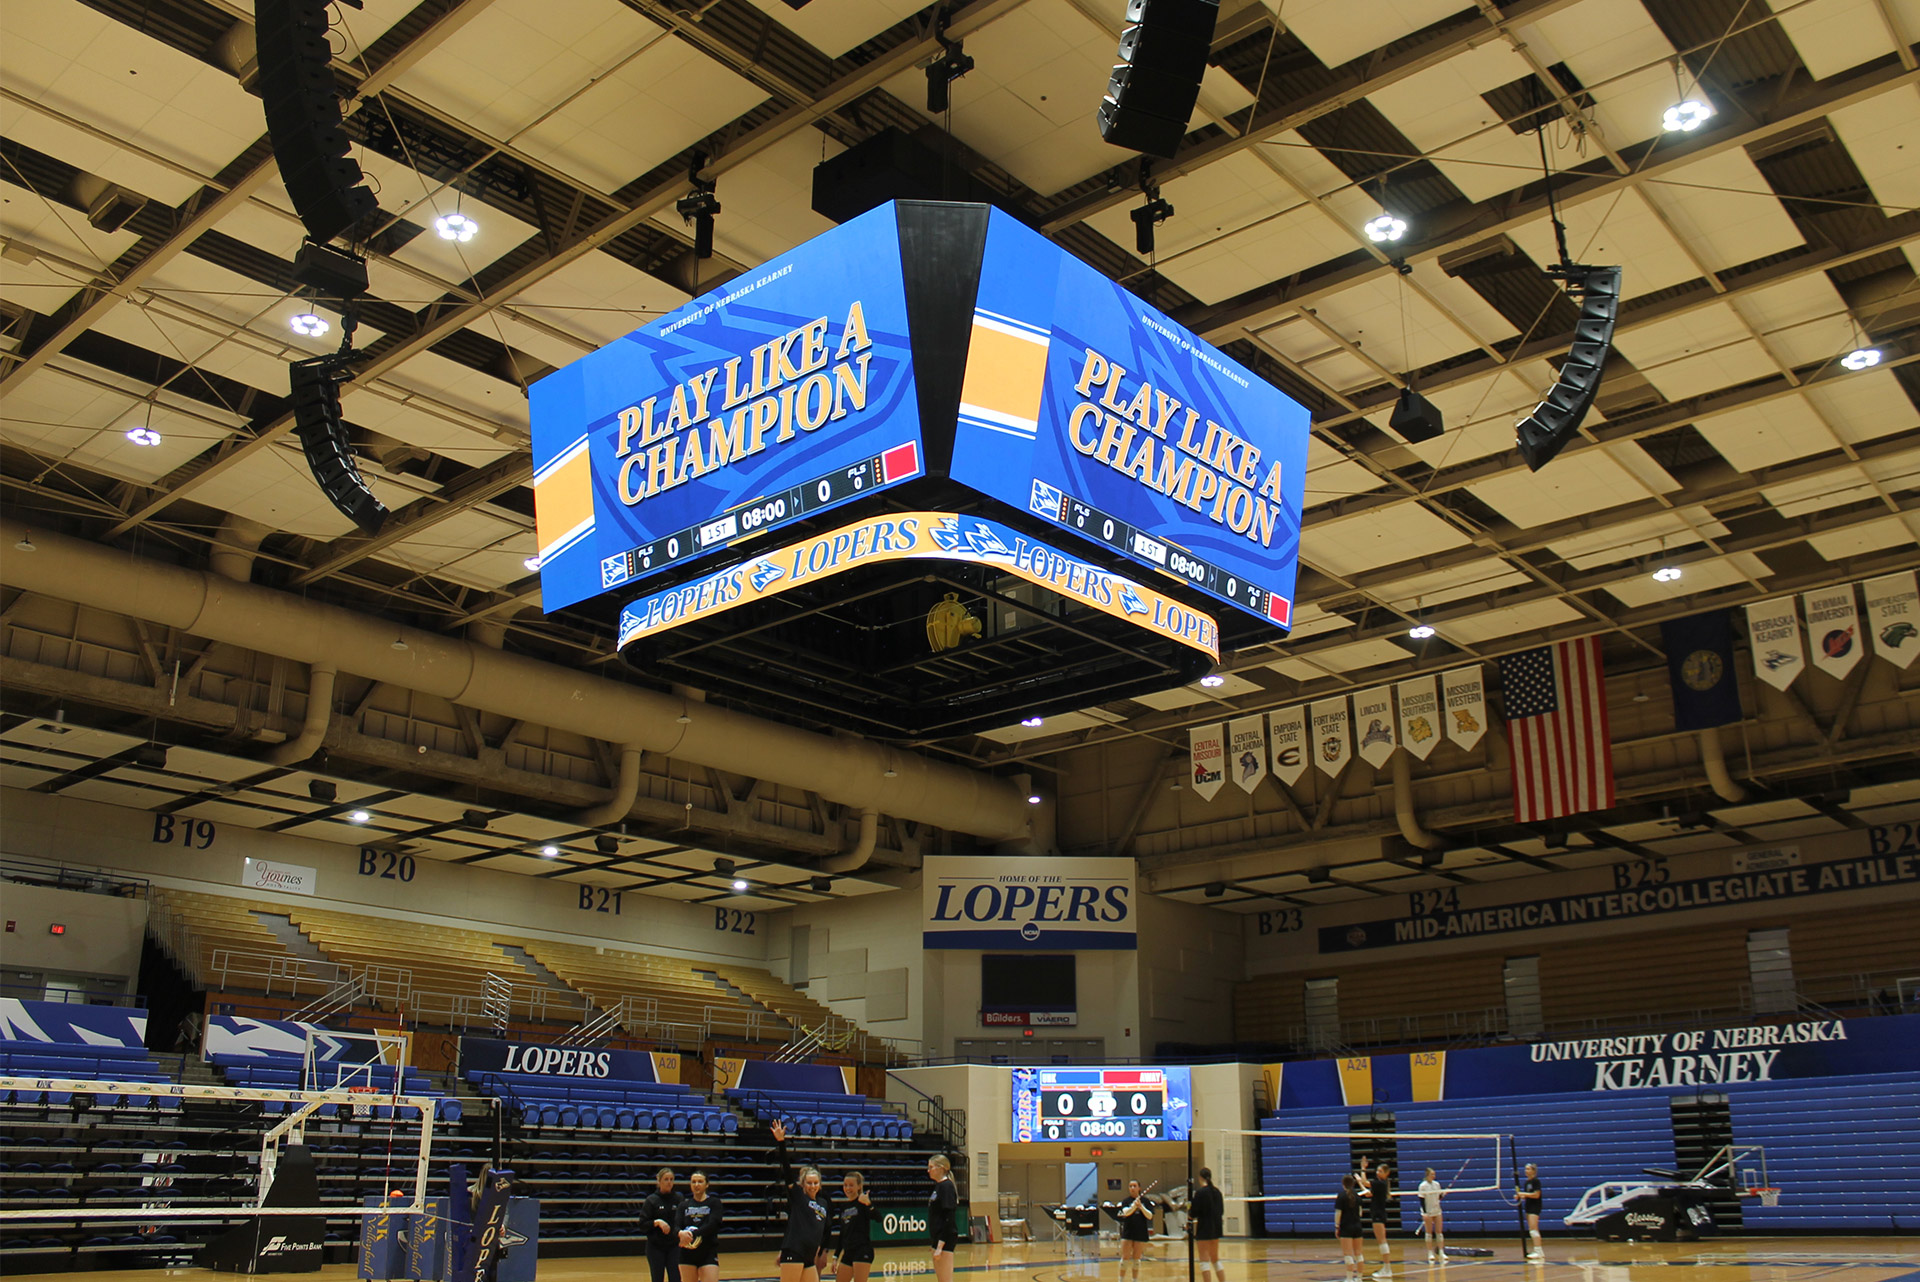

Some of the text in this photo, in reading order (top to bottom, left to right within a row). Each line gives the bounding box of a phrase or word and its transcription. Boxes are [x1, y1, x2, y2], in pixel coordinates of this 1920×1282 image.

[660, 263, 793, 337] UNIVERSITY OF NEBRASKA KEARNEY
[1141, 315, 1250, 389] UNIVERSITY OF NEBRASKA KEARNEY
[616, 301, 871, 459] PLAY LIKE A
[617, 352, 872, 507] CHAMPION
[1074, 348, 1282, 505] PLAY LIKE A
[848, 464, 866, 479] FLS
[1068, 401, 1281, 549] CHAMPION
[817, 480, 831, 502] 0
[854, 477, 862, 490] 0
[741, 499, 785, 530] 08:00
[1074, 503, 1090, 517] FLS
[1077, 516, 1084, 528] 0
[1102, 519, 1114, 541] 0
[707, 523, 727, 540] 1ST
[638, 545, 653, 558] FLS
[667, 538, 679, 559] 0
[789, 519, 918, 581] LOPERS
[1140, 542, 1159, 558] 1ST
[643, 556, 650, 569] 0
[1170, 552, 1204, 582] 08:00
[1012, 537, 1114, 606] LOPERS
[1226, 577, 1236, 597] 0
[1247, 585, 1261, 598] FLS
[645, 570, 744, 629] LOPERS
[1250, 595, 1256, 607] 0
[1808, 606, 1854, 624] UNIVERSITY
[1880, 602, 1908, 618] STATE
[1152, 597, 1219, 653] LOPER
[1752, 614, 1795, 632] NEBRASKA
[1756, 626, 1794, 643] KEARNEY
[1446, 682, 1480, 697] MISSOURI
[1401, 691, 1435, 708] MISSOURI
[1447, 691, 1481, 707] WESTERN
[1360, 702, 1387, 716] LINCOLN
[1402, 702, 1436, 718] SOUTHERN
[1313, 710, 1346, 726] FORT HAYS
[1273, 720, 1302, 736] EMPORIA
[1321, 722, 1341, 735] STATE
[1194, 738, 1220, 752] CENTRAL
[1231, 738, 1264, 754] OKLAHOMA
[1233, 730, 1260, 745] CENTRAL
[1279, 732, 1299, 744] STATE
[1193, 747, 1221, 761] MISSOURI
[1195, 770, 1221, 785] UCM
[152, 813, 216, 850] B19
[358, 847, 416, 883] B20
[256, 861, 303, 887] Younes
[999, 875, 1062, 883] HOME OF THE
[1612, 857, 1671, 891] B25
[578, 885, 622, 915] B21
[930, 884, 1129, 922] LOPERS
[1394, 903, 1557, 942] MID-AMERICA
[1561, 869, 1809, 921] INTERCOLLEGIATE
[1408, 887, 1461, 917] B24
[715, 907, 756, 935] B22
[1258, 908, 1304, 936] B23
[1530, 1020, 1848, 1063] UNIVERSITY OF NEBRASKA
[502, 1045, 611, 1079] LOPERS
[658, 1056, 677, 1070] A20
[721, 1060, 736, 1073] A21
[1346, 1058, 1368, 1071] A24
[1414, 1052, 1437, 1066] A25
[1140, 1072, 1161, 1082] AWAY
[1592, 1049, 1781, 1092] KEARNEY
[1057, 1093, 1074, 1115] 0
[1099, 1101, 1105, 1112] 1
[1131, 1093, 1147, 1115] 0
[1019, 1089, 1032, 1142] OPERS
[1048, 1125, 1059, 1139] 0
[1080, 1121, 1125, 1137] 08:00
[1146, 1125, 1157, 1139] 0
[423, 1203, 437, 1242] UNK
[899, 1216, 926, 1232] fnbo
[361, 1217, 377, 1276] Volleyball
[408, 1218, 424, 1277] Volleyball
